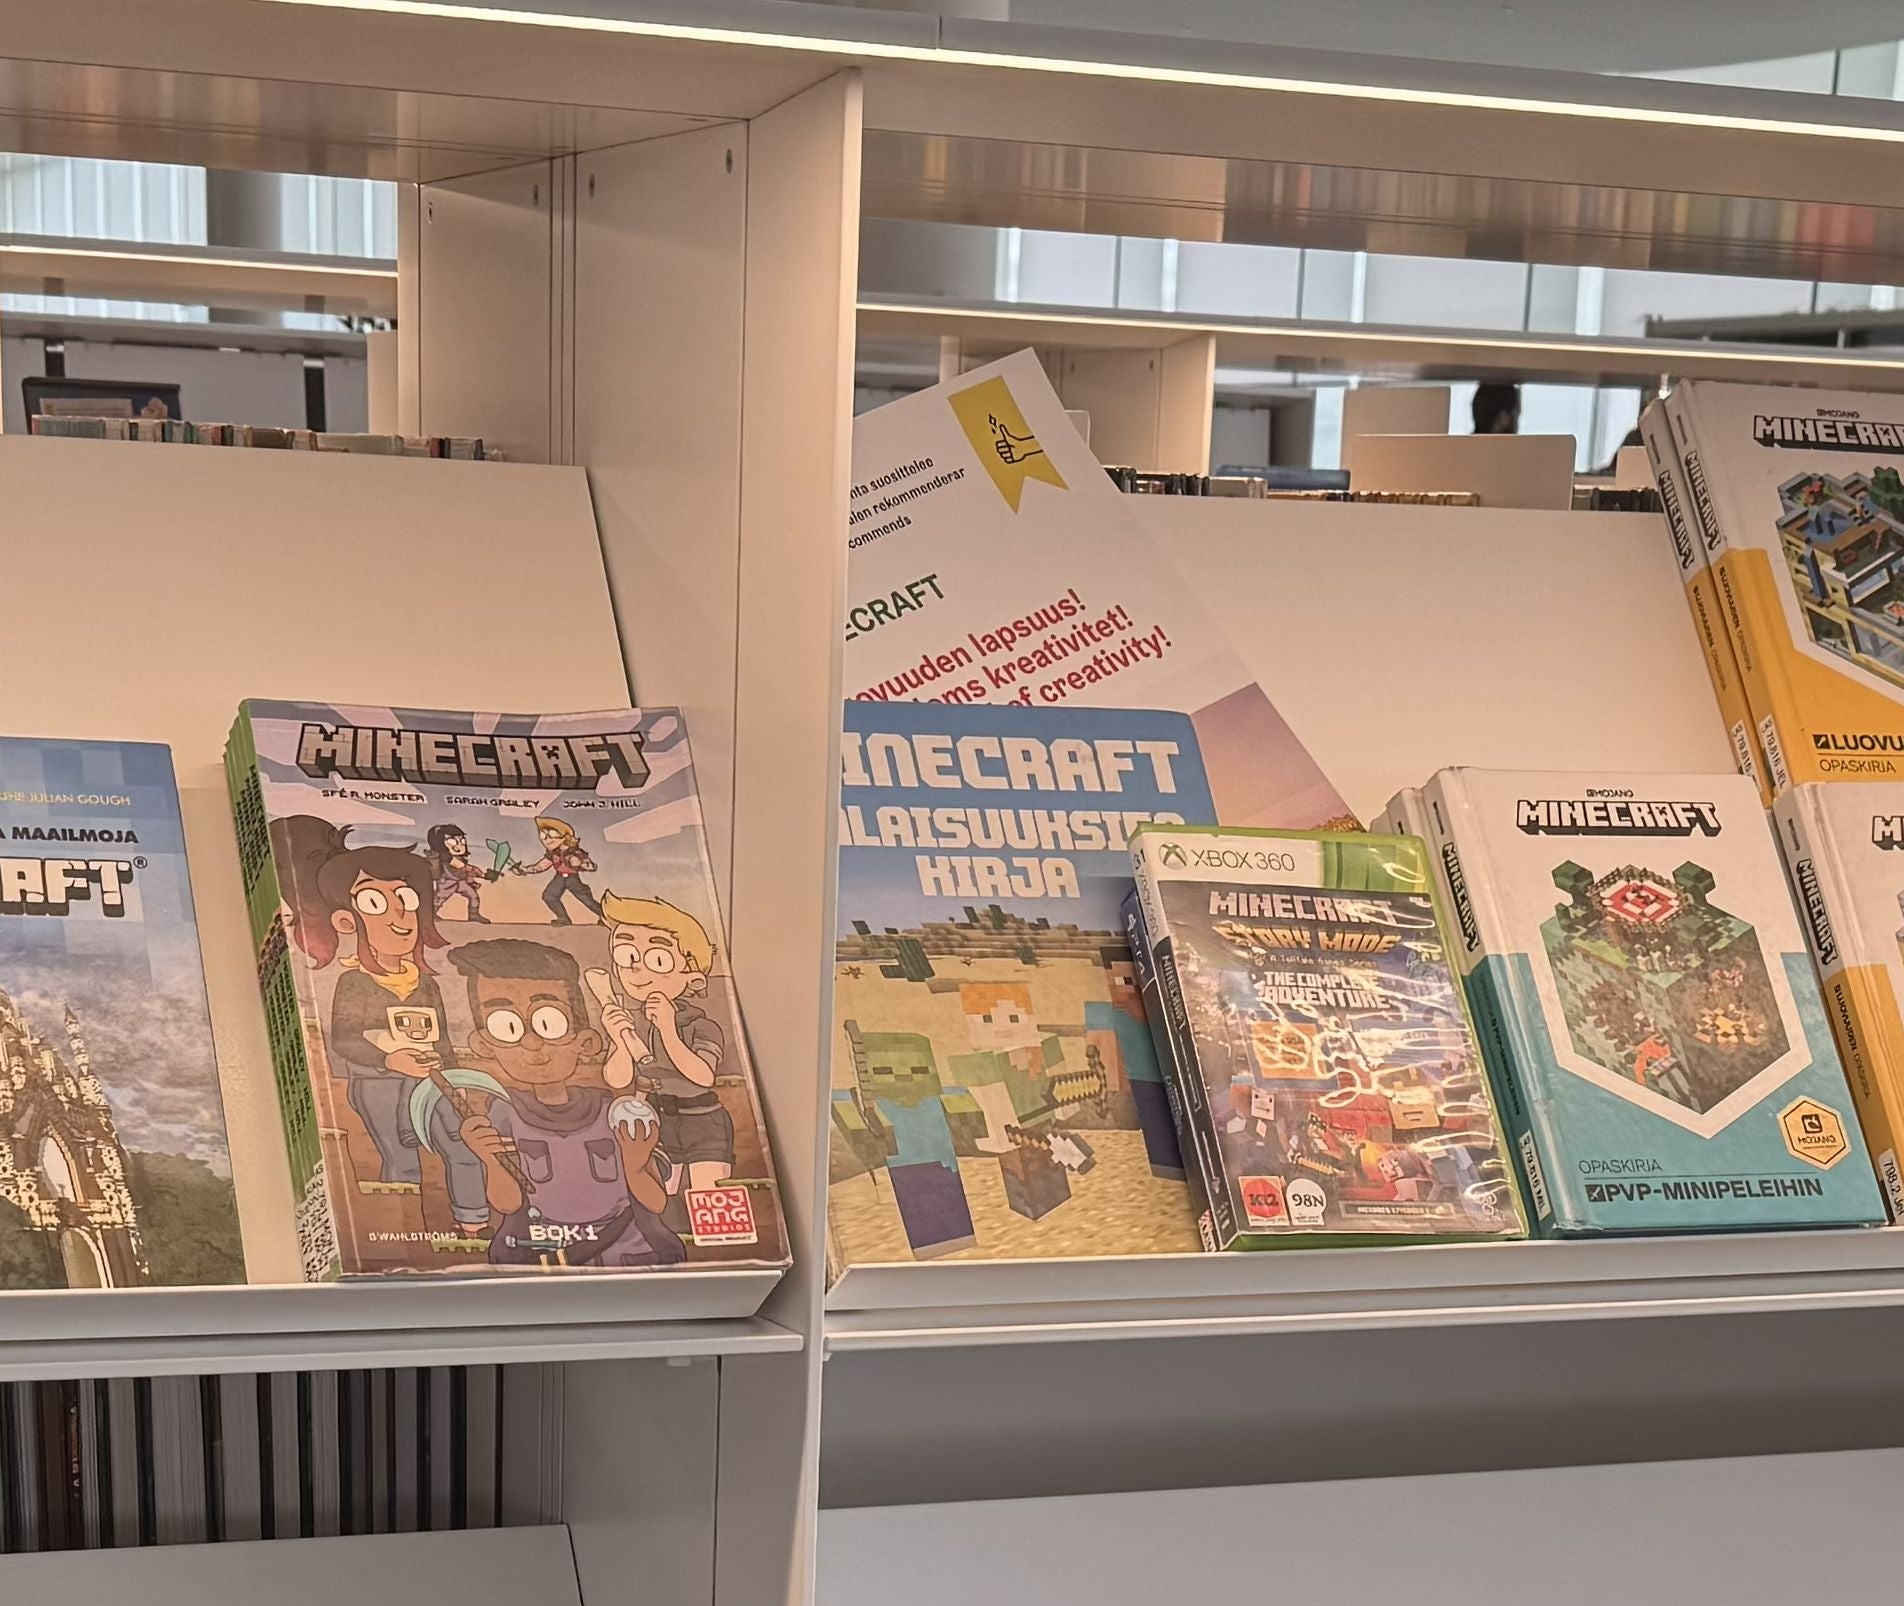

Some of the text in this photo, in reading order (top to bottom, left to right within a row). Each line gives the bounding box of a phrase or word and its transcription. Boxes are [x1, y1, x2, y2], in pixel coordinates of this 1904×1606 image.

[1684, 450, 1723, 551] MINECRAFT
[973, 588, 1087, 660] lapsuus!
[995, 604, 1134, 688] kreativitet!
[1038, 625, 1173, 706] creativity!
[296, 723, 652, 791] MINECRAFT
[1819, 758, 1897, 774] OPASKIRJA
[365, 790, 425, 803] MONSTER
[1516, 799, 1723, 837] MINECRAFT
[12, 825, 138, 844] MAAILMOJA
[1191, 849, 1296, 872] XBOX 360
[915, 855, 1081, 898] KIRJA
[1319, 930, 1402, 955] MODE
[1578, 1158, 1663, 1175] OPASKIRJA
[1291, 1192, 1325, 1208] 98N
[1605, 1179, 1823, 1202] PVP-MINIPELEIHIN
[529, 1223, 599, 1242] BOK 1
